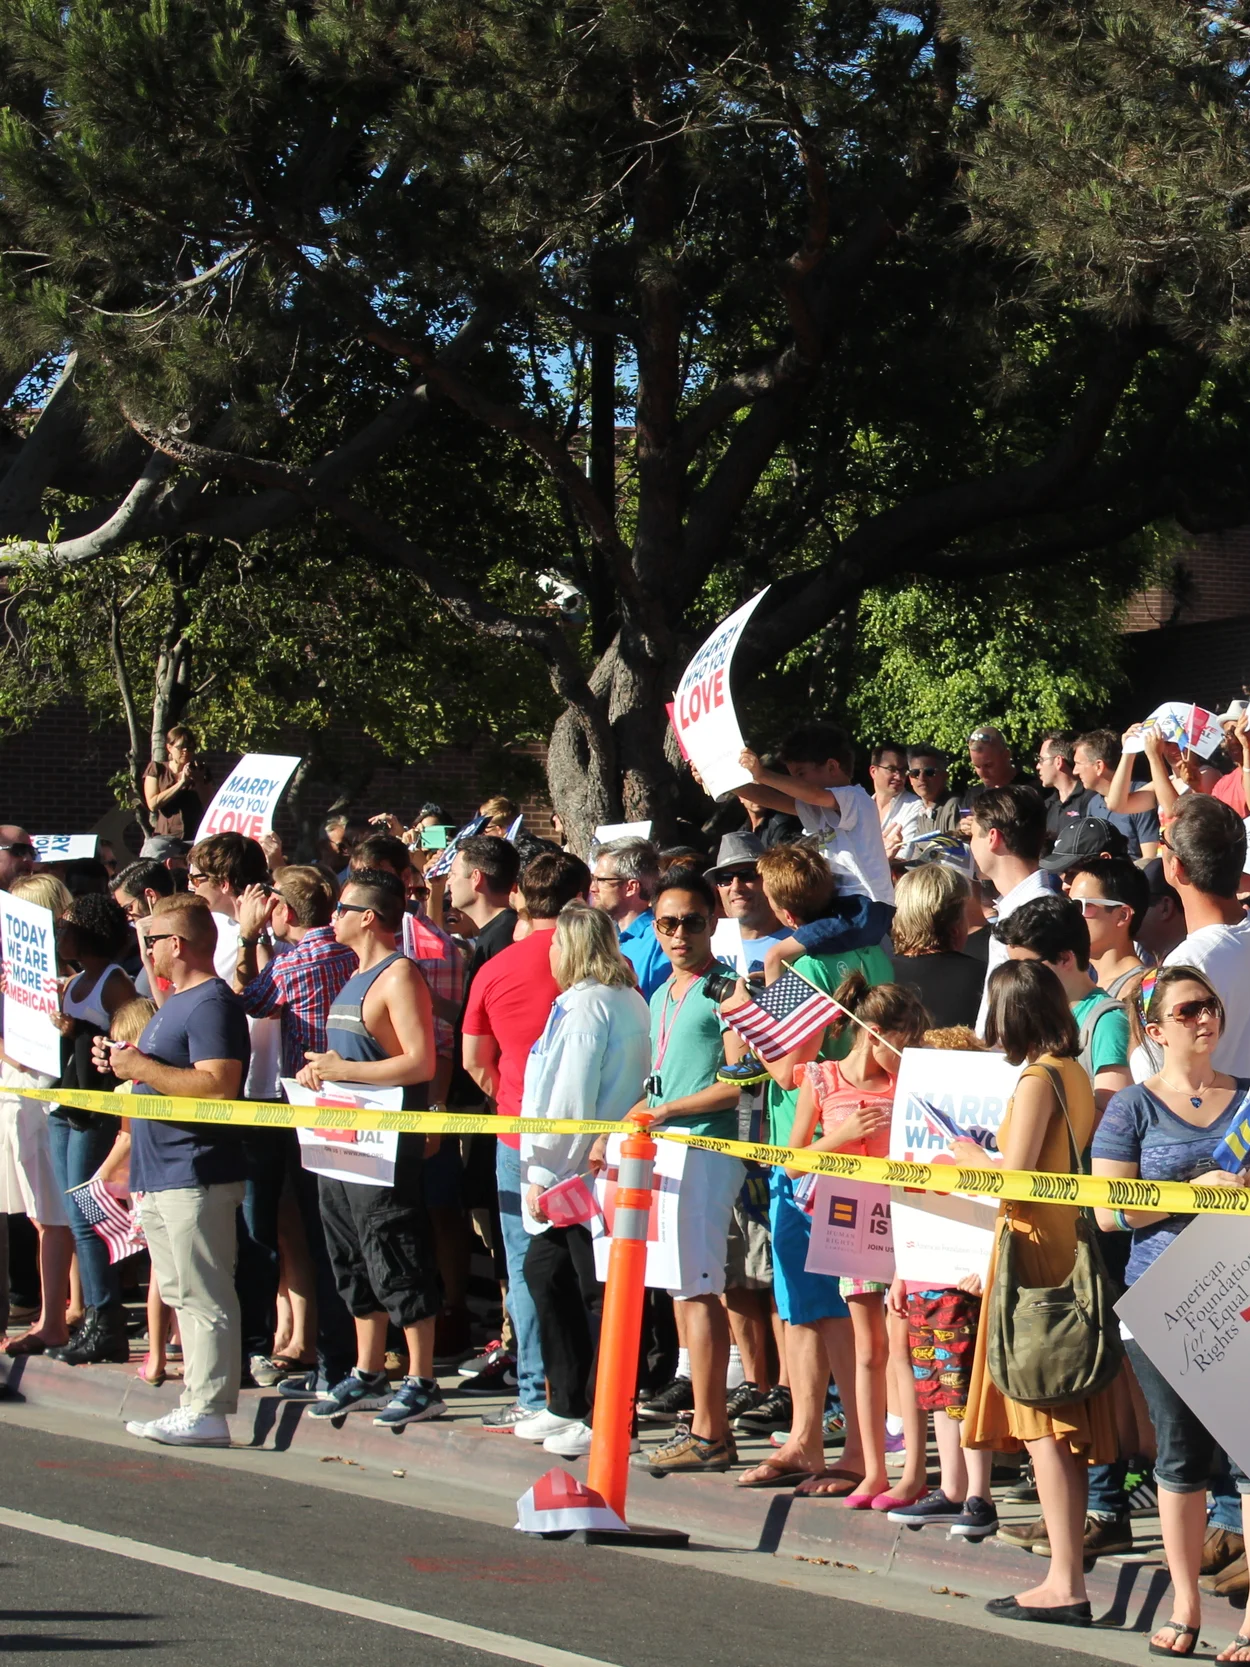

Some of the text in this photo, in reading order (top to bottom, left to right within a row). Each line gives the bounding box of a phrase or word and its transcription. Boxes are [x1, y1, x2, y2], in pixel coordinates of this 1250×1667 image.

[690, 617, 745, 670] MARRY
[683, 645, 731, 691] WHO YOU
[680, 667, 724, 731] LOVE
[218, 794, 269, 814] WHO YOU
[226, 776, 279, 797] MARRY
[206, 808, 264, 842] LOVE
[6, 913, 47, 949] TODAY
[7, 937, 49, 972] WE ARE
[12, 963, 42, 991] MORE
[5, 980, 57, 1015] AMERICAN
[905, 1091, 1004, 1126] MARR
[350, 1129, 384, 1144] UAL
[905, 1125, 1000, 1153] WH YO
[882, 1161, 932, 1184] CAUTION
[954, 1168, 1004, 1193] CAUTION
[1030, 1174, 1079, 1200] CAUTION
[1107, 1180, 1161, 1206] CAUTION
[1192, 1186, 1250, 1211] CAUTION
[869, 1219, 888, 1235] IS
[867, 1244, 883, 1252] JOIN
[1163, 1260, 1226, 1331] American
[1180, 1284, 1250, 1376] for Equal
[1192, 1323, 1240, 1373] Rights
